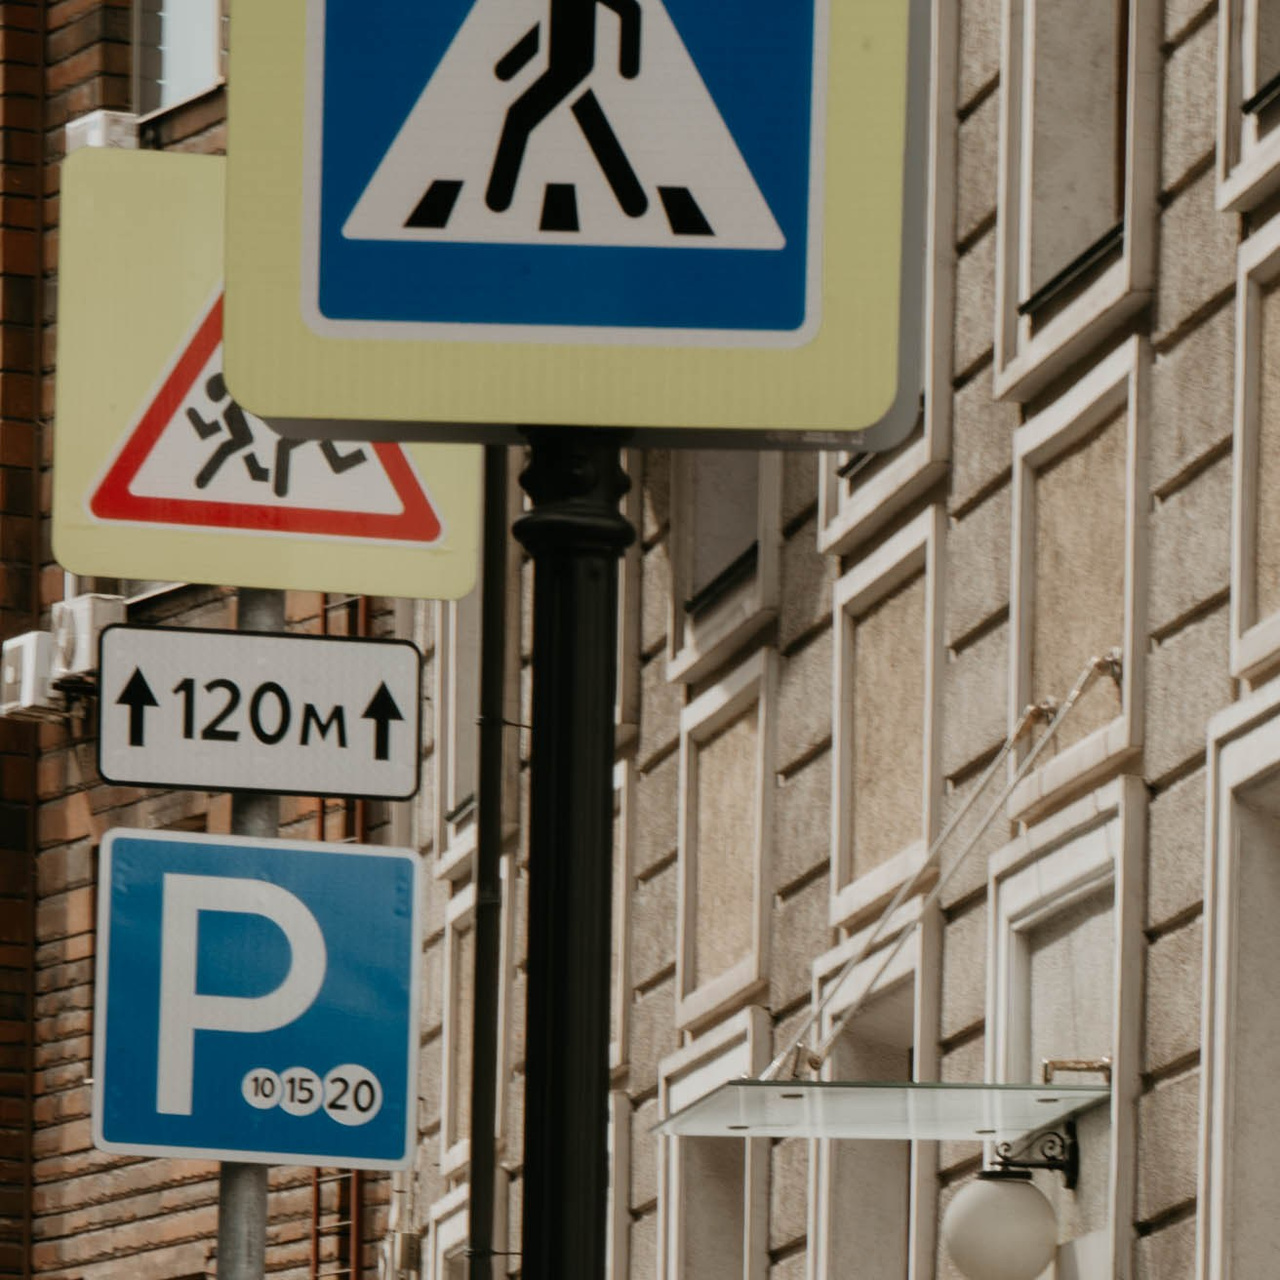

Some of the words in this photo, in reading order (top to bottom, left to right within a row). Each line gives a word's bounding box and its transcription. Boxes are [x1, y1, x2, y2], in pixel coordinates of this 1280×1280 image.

[156, 872, 328, 1117] P
[252, 1076, 275, 1098] 10
[286, 1077, 314, 1104] 15
[327, 1077, 375, 1113] 20
